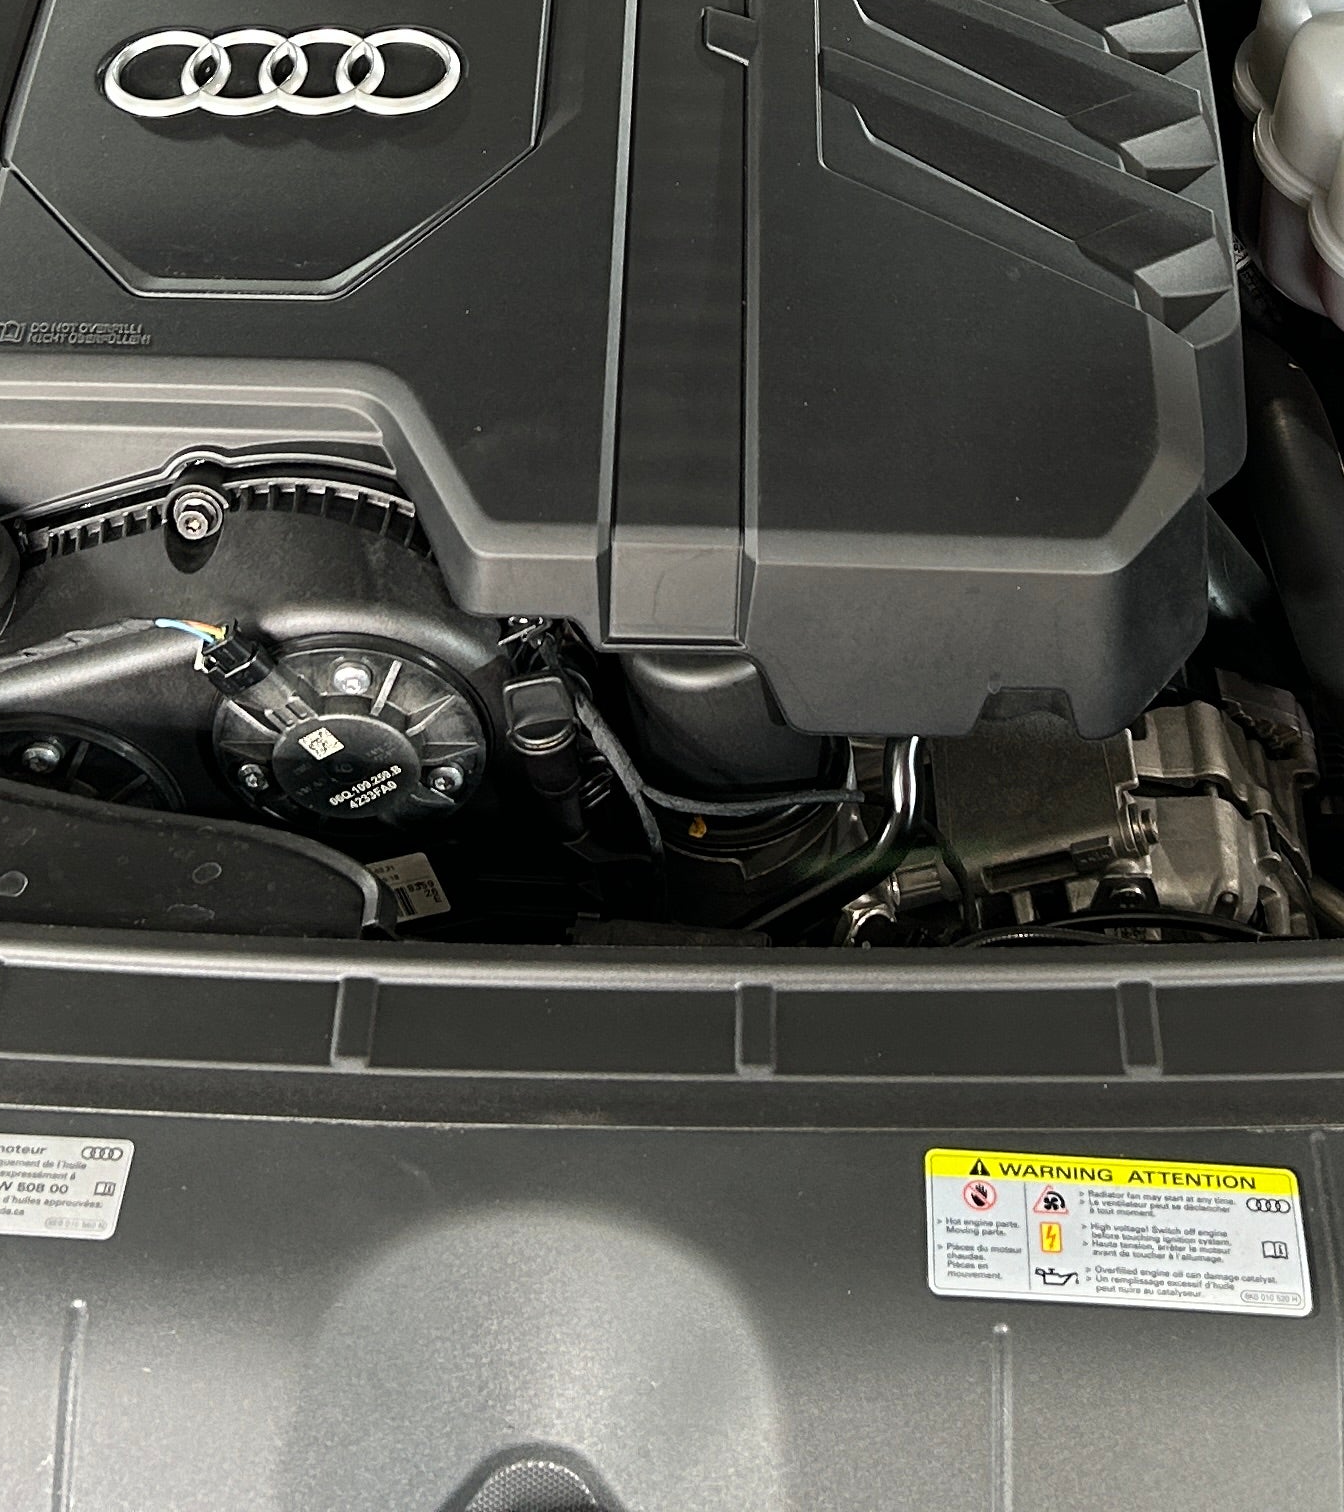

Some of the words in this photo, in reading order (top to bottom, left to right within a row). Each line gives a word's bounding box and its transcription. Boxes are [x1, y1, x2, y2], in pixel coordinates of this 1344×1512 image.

[31, 322, 49, 333] DO
[52, 322, 77, 333] NOT
[1000, 1163, 1113, 1182] WARNING
[1127, 1169, 1257, 1190] ATTENTION
[17, 1182, 45, 1193] 508
[49, 1184, 69, 1194] 00
[1089, 1190, 1124, 1199] Radiator
[964, 1219, 993, 1227] engine
[946, 1226, 979, 1235] Moving
[1152, 1226, 1181, 1235] Switch
[1198, 1229, 1227, 1239] engine
[1092, 1231, 1120, 1240] before
[1122, 1233, 1160, 1244] touching
[1163, 1235, 1196, 1246] ignition
[991, 1246, 1021, 1254] moteur
[1092, 1239, 1117, 1248] Haute
[1200, 1247, 1231, 1255] moteur
[1133, 1250, 1165, 1259] toucher
[1095, 1265, 1137, 1276] Overfilled
[1140, 1269, 1170, 1279] engine
[1204, 1272, 1240, 1283] damage
